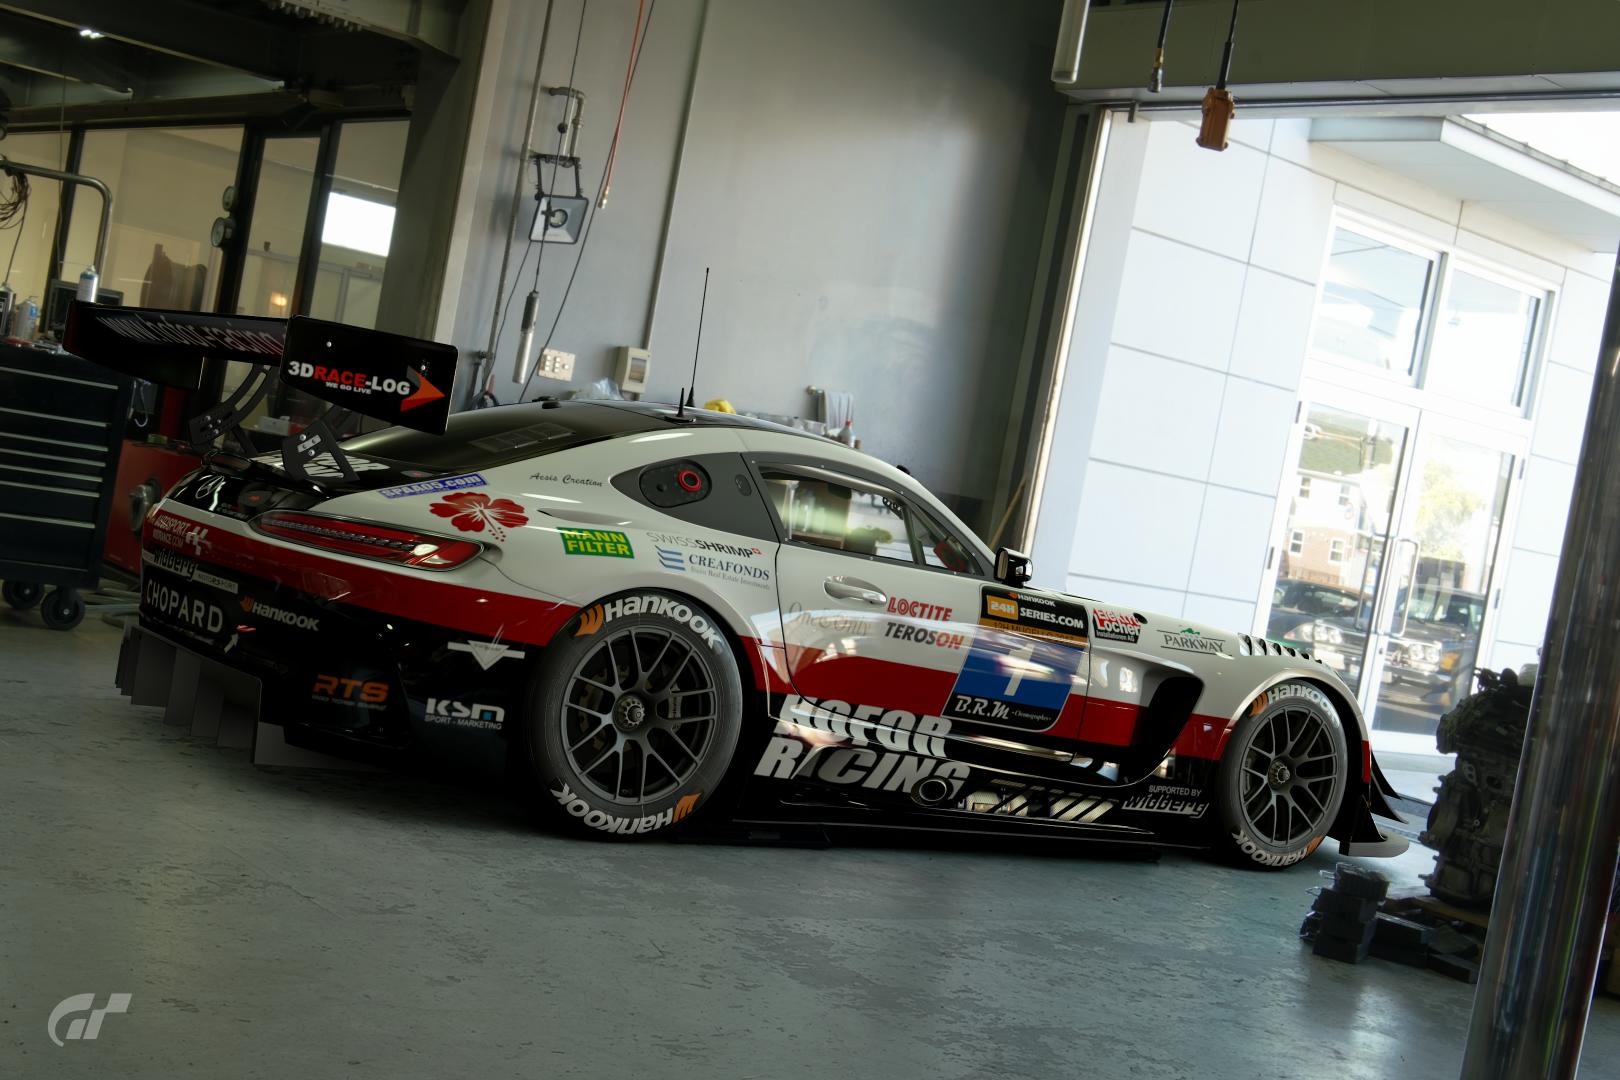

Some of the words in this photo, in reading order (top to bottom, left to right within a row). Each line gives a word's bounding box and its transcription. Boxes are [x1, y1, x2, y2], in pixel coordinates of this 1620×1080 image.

[288, 361, 410, 395] 3DRACE-LOG
[325, 381, 339, 389] WE
[353, 386, 372, 395] LIVE
[562, 474, 603, 487] Creation
[562, 528, 627, 543] MANN
[567, 541, 631, 556] FILTER
[689, 553, 770, 581] CREAFONDS
[146, 578, 223, 634] CHOPARD
[887, 597, 952, 621] LOCTITE
[990, 601, 1016, 616] 24H
[1020, 606, 1084, 629] SERIES.COM
[884, 622, 965, 650] TEROSON
[1093, 613, 1142, 636] Locher
[1163, 635, 1225, 653] PARKWAY
[312, 674, 389, 703] RTS
[424, 714, 451, 725] SPORT
[457, 718, 502, 730] MARKETING
[773, 694, 952, 758] HOFOR
[1148, 784, 1190, 796] SUPPORTED
[1191, 788, 1202, 797] BY
